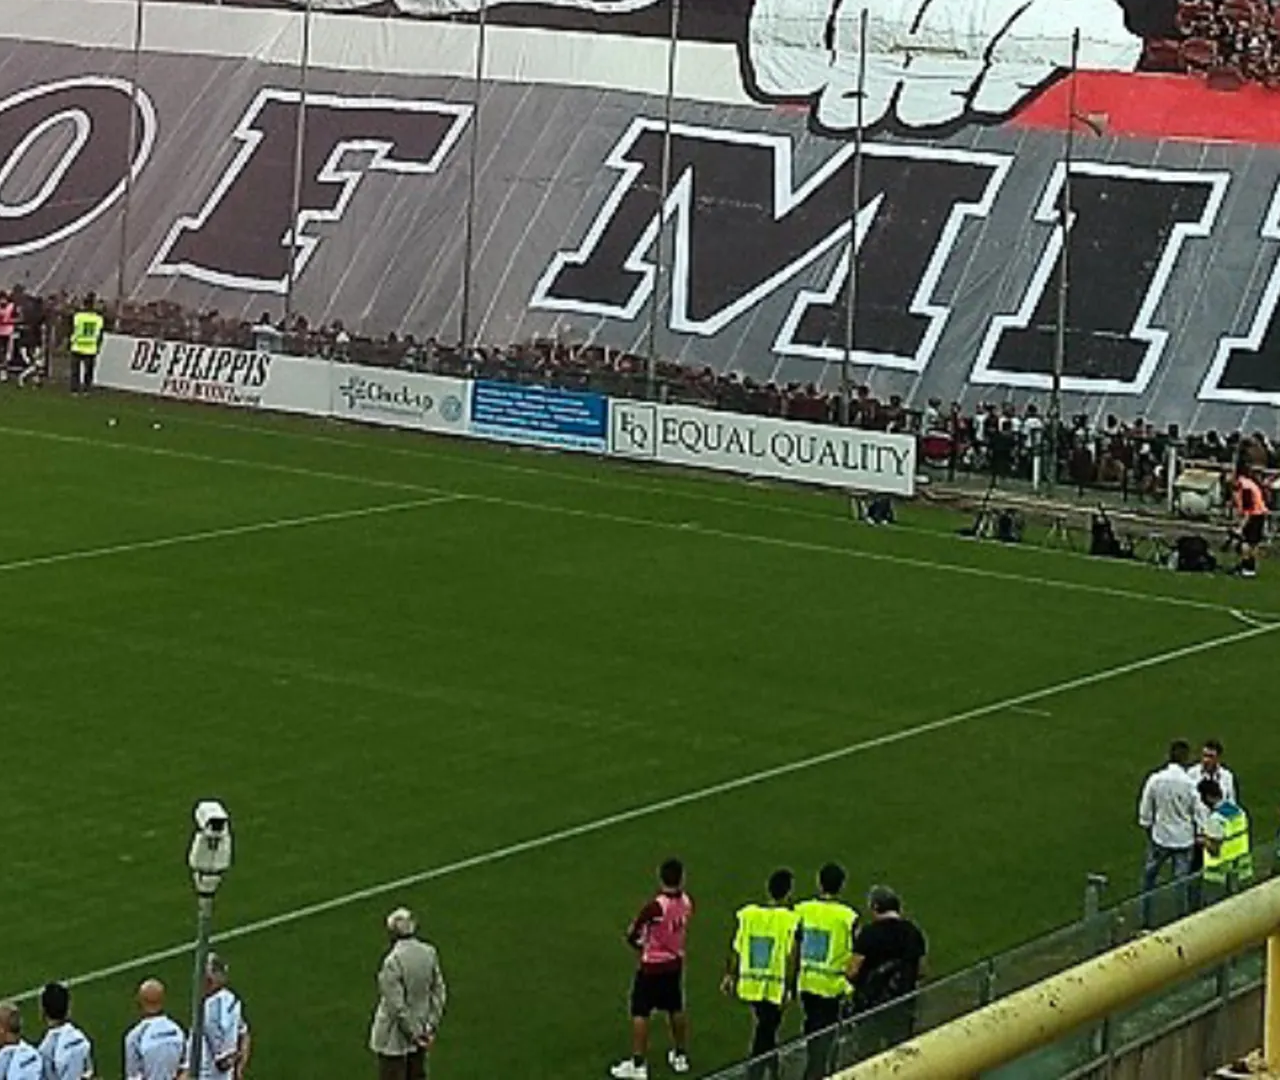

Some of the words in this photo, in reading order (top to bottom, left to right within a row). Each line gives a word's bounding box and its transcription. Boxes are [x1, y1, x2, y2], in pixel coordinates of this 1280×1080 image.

[131, 341, 164, 373] DE
[167, 344, 270, 387] FILIPPIS
[661, 417, 766, 457] EQUAL
[771, 433, 910, 476] QUALITY
